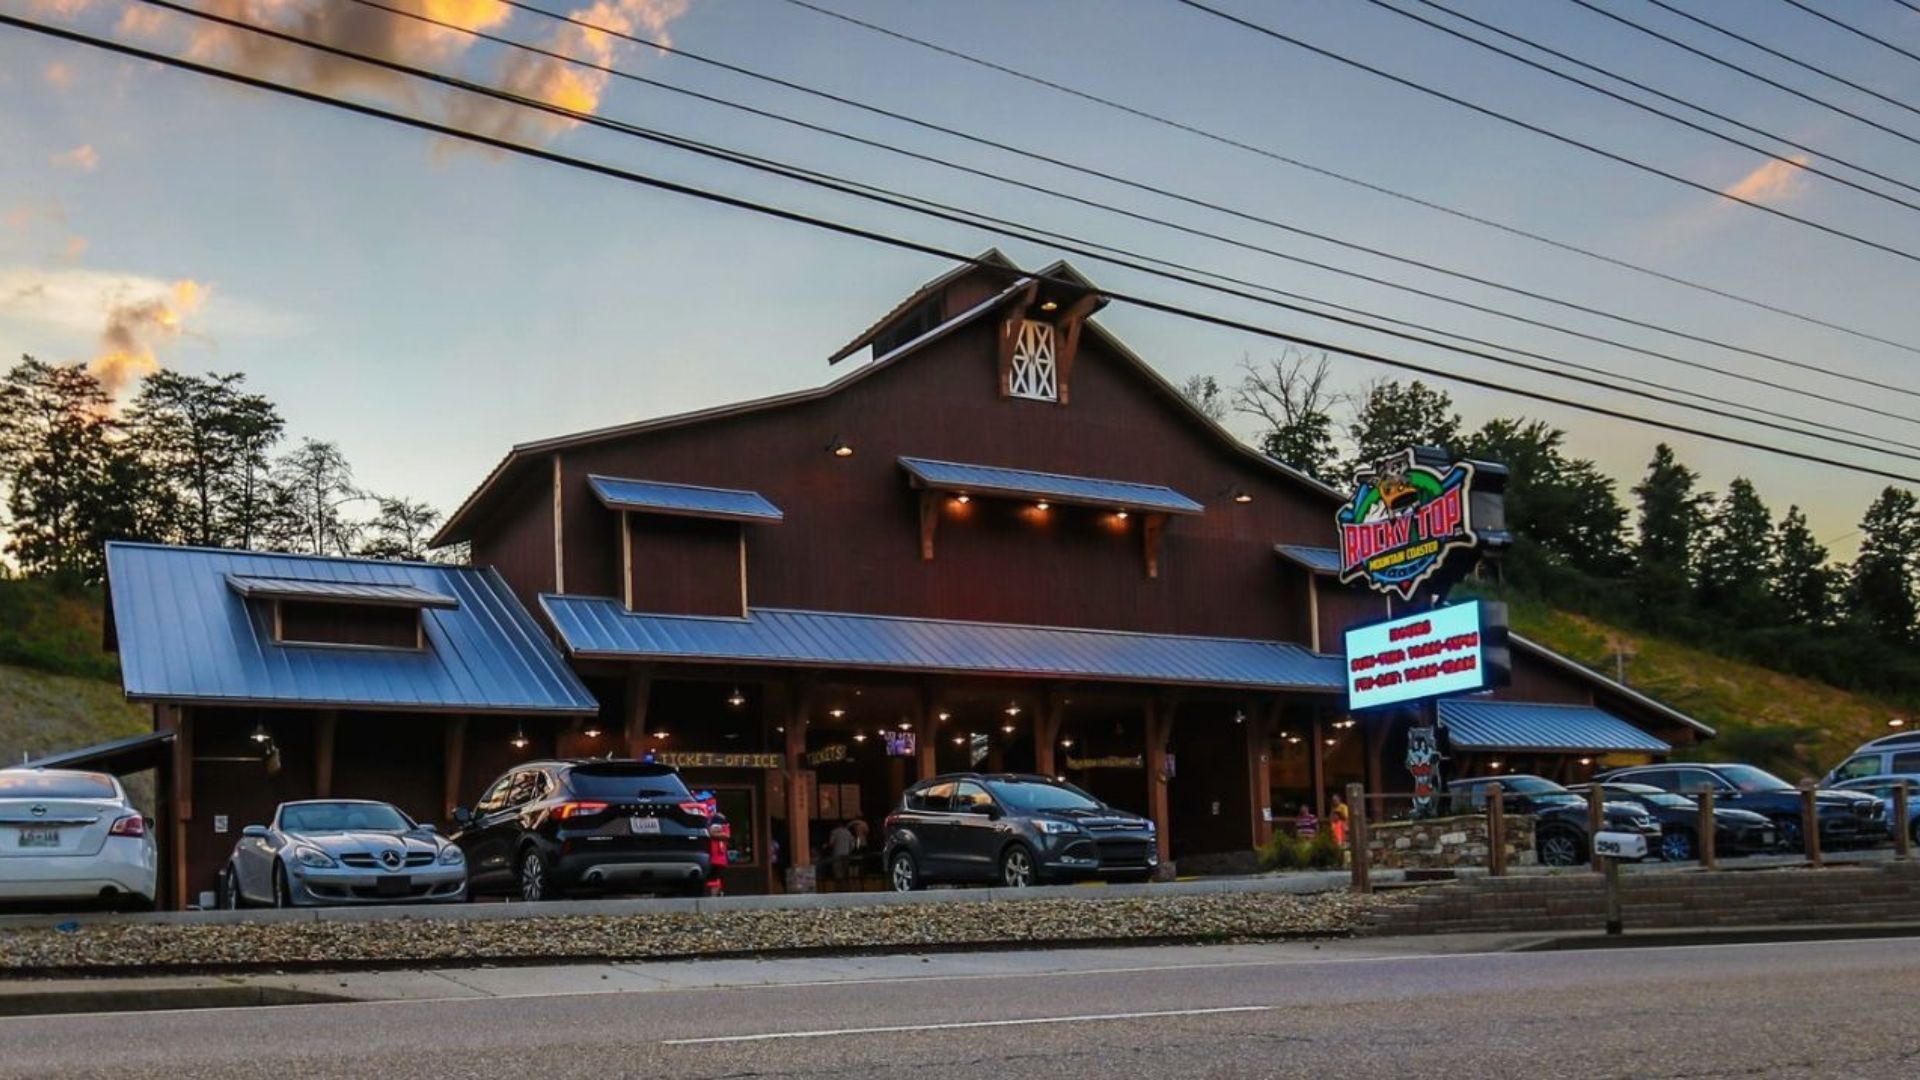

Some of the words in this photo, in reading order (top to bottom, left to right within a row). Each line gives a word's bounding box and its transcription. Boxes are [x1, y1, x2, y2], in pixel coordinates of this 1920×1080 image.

[1342, 510, 1411, 572] ROCKY
[1414, 483, 1461, 540] TOP
[1405, 540, 1439, 560] COASTER
[660, 752, 780, 768] TICKET-OFFICE
